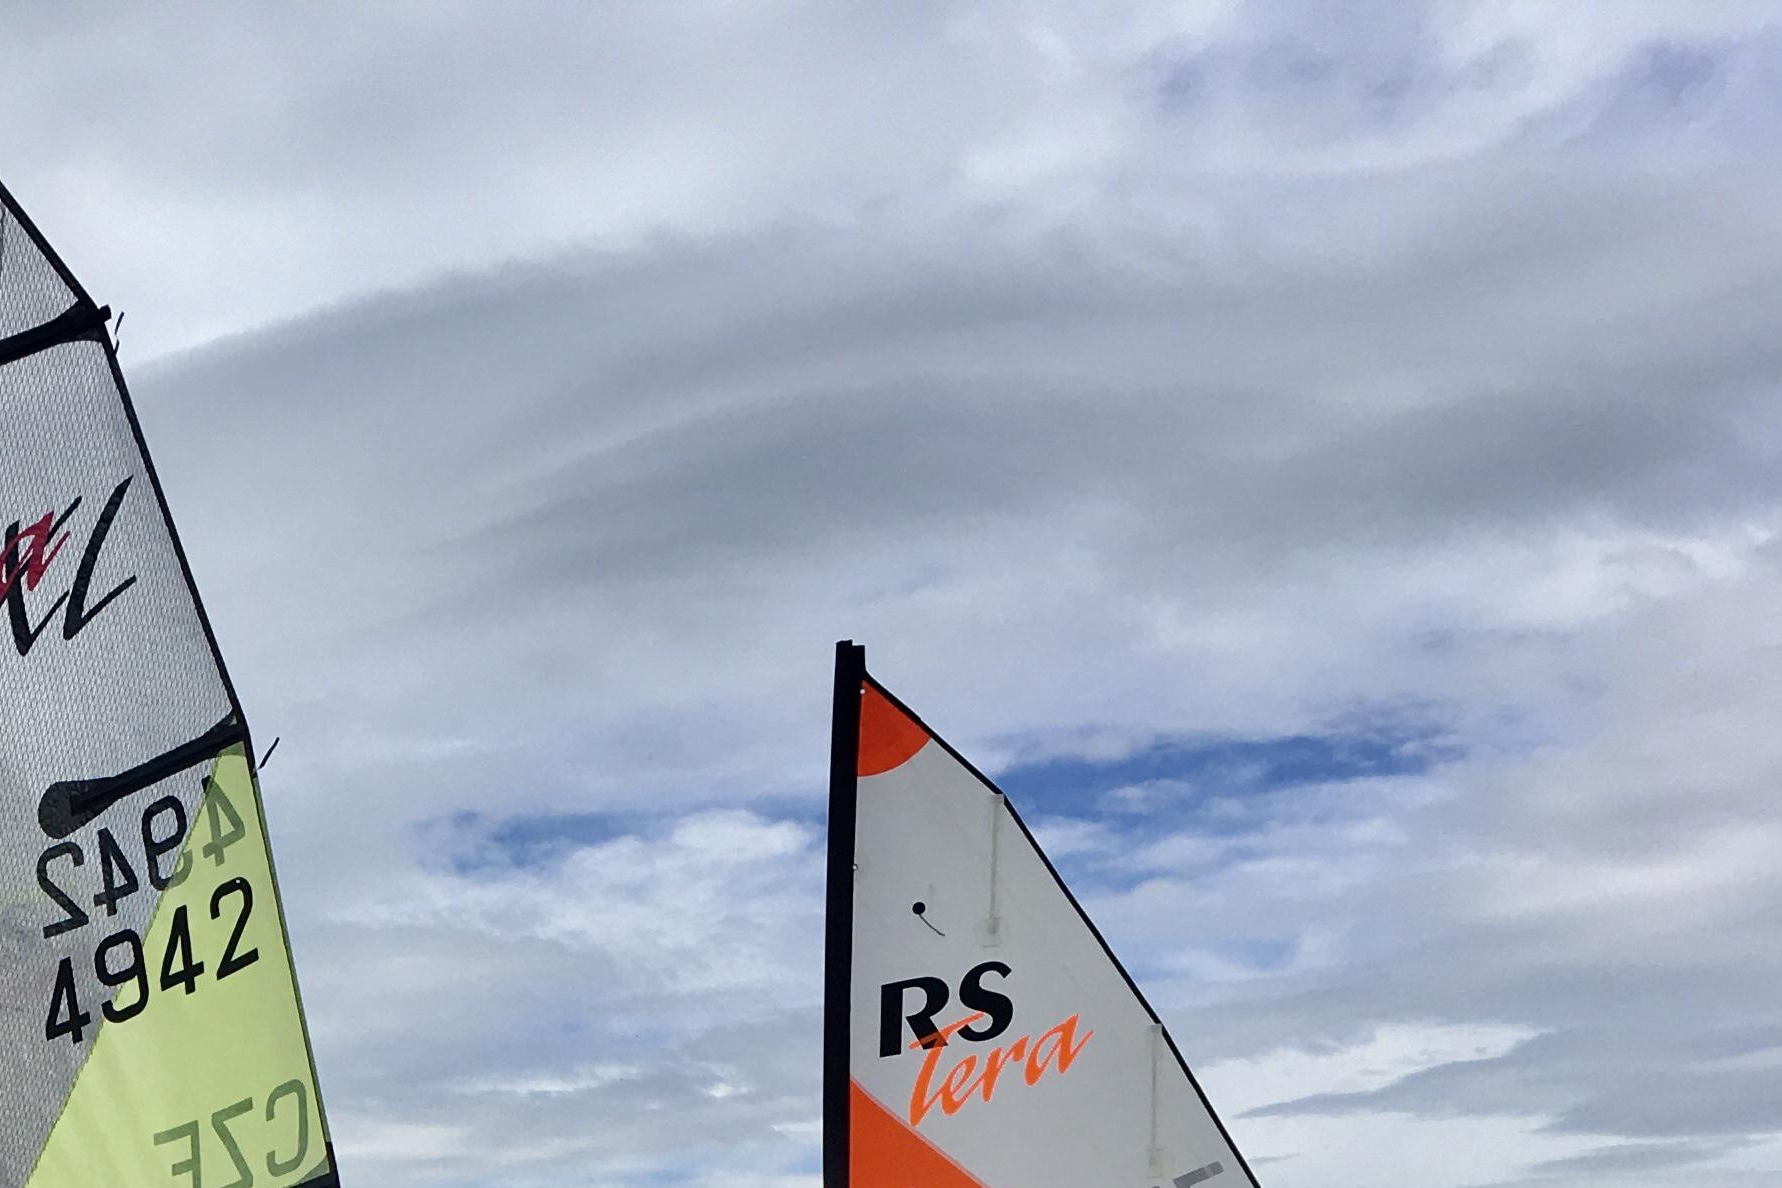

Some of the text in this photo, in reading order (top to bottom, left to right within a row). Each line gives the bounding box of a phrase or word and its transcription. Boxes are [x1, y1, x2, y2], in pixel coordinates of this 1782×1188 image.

[45, 876, 259, 1044] 4942
[879, 961, 1014, 1058] RS
[908, 1011, 1094, 1127] Tera
